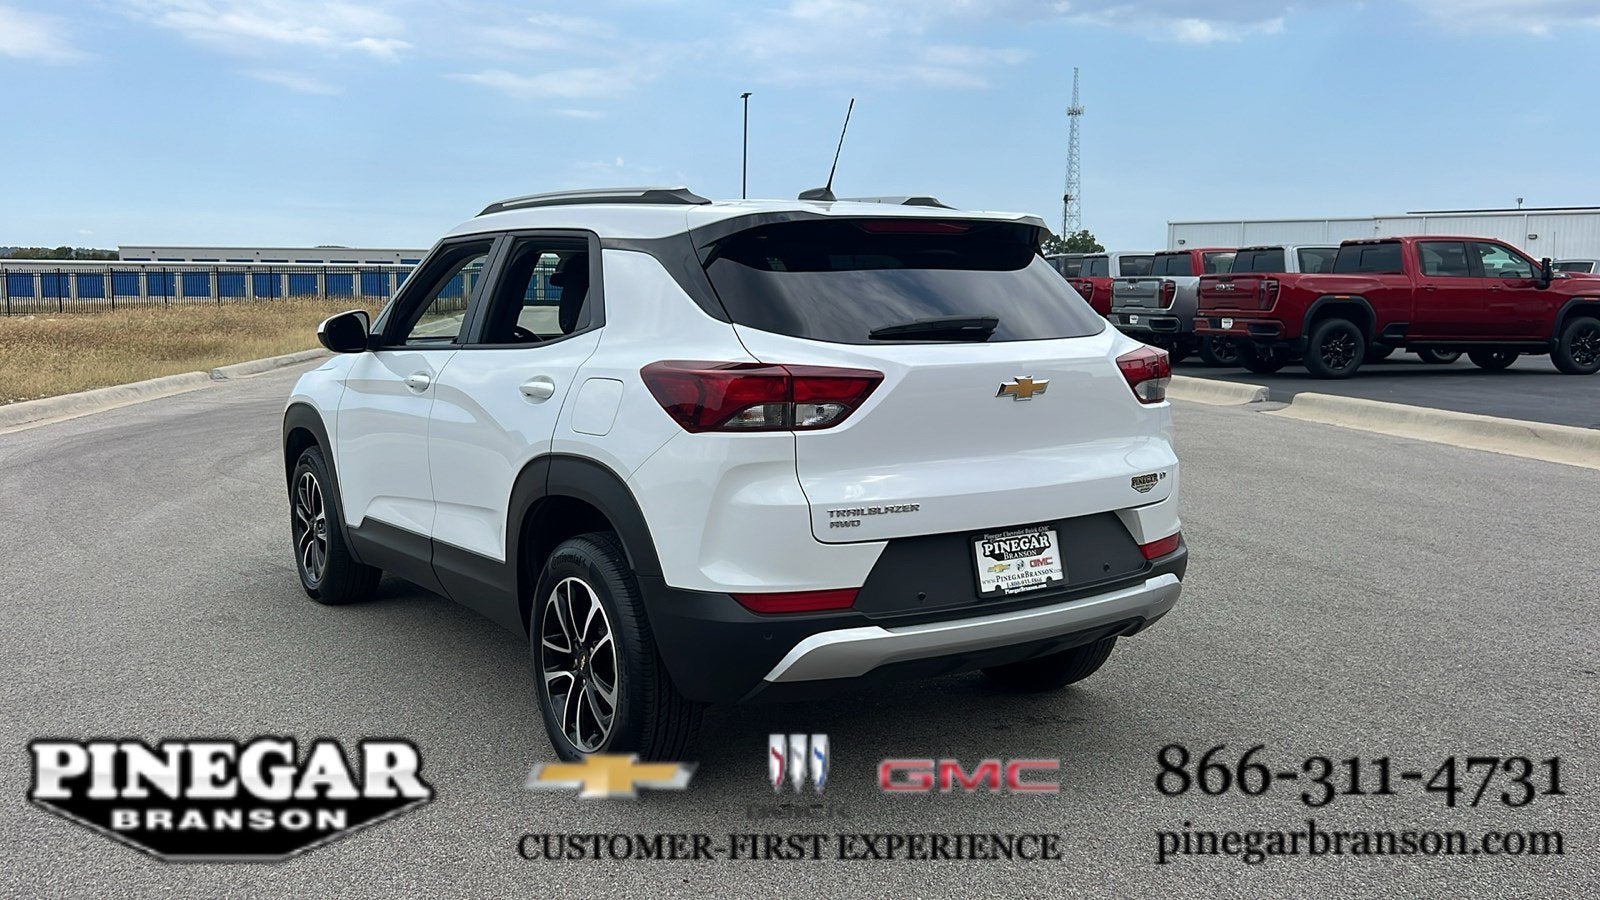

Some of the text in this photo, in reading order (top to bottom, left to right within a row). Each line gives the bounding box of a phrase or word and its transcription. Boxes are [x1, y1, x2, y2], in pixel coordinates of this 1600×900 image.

[827, 503, 920, 518] TRAILBLAZER
[830, 520, 861, 529] AWD
[984, 533, 1002, 541] Pinegar
[1003, 529, 1025, 537] Chevrolet
[1025, 527, 1038, 535] Buick
[983, 535, 1050, 556] PINEGAR
[1003, 549, 1038, 560] BRANSON
[1029, 557, 1054, 568] GMC
